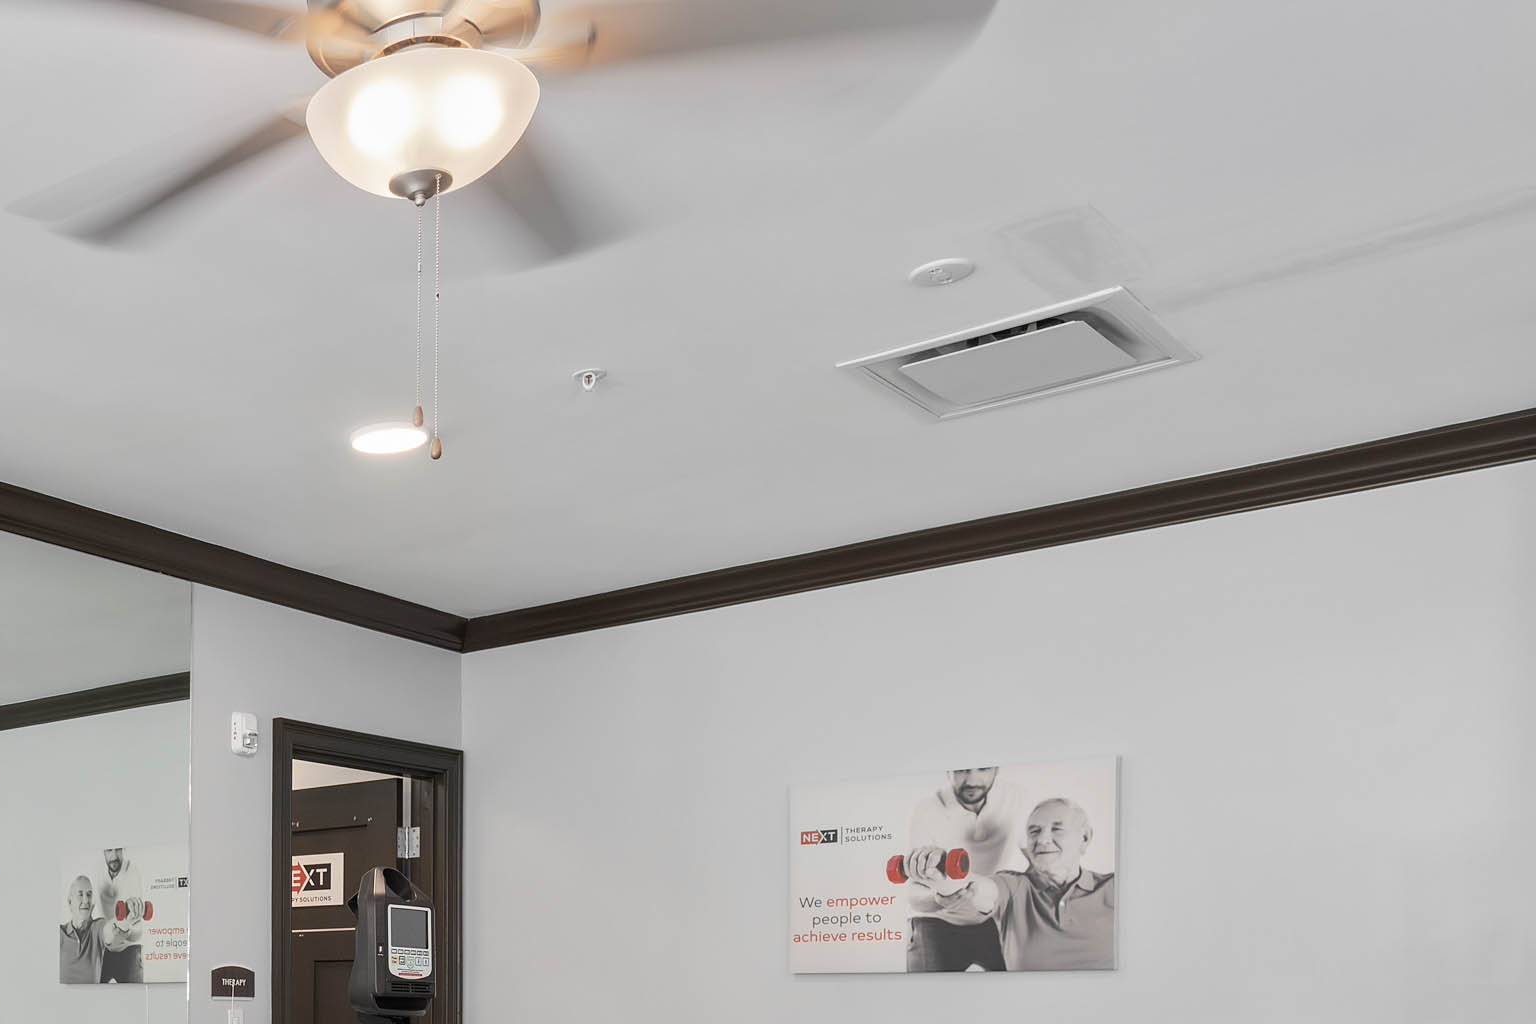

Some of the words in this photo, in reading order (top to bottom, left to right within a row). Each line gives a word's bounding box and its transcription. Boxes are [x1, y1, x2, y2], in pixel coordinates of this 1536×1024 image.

[801, 829, 837, 845] NEXT
[845, 826, 883, 834] THERAPY
[845, 834, 892, 842] SOLUTIONS
[292, 866, 328, 888] EXT
[299, 895, 332, 903] SOLUTIONS
[799, 897, 822, 909] We
[826, 896, 896, 910] empower
[812, 911, 861, 928] people
[866, 912, 882, 924] to
[793, 930, 847, 943] achieve
[851, 928, 902, 941] results
[221, 978, 247, 986] THERAPY
